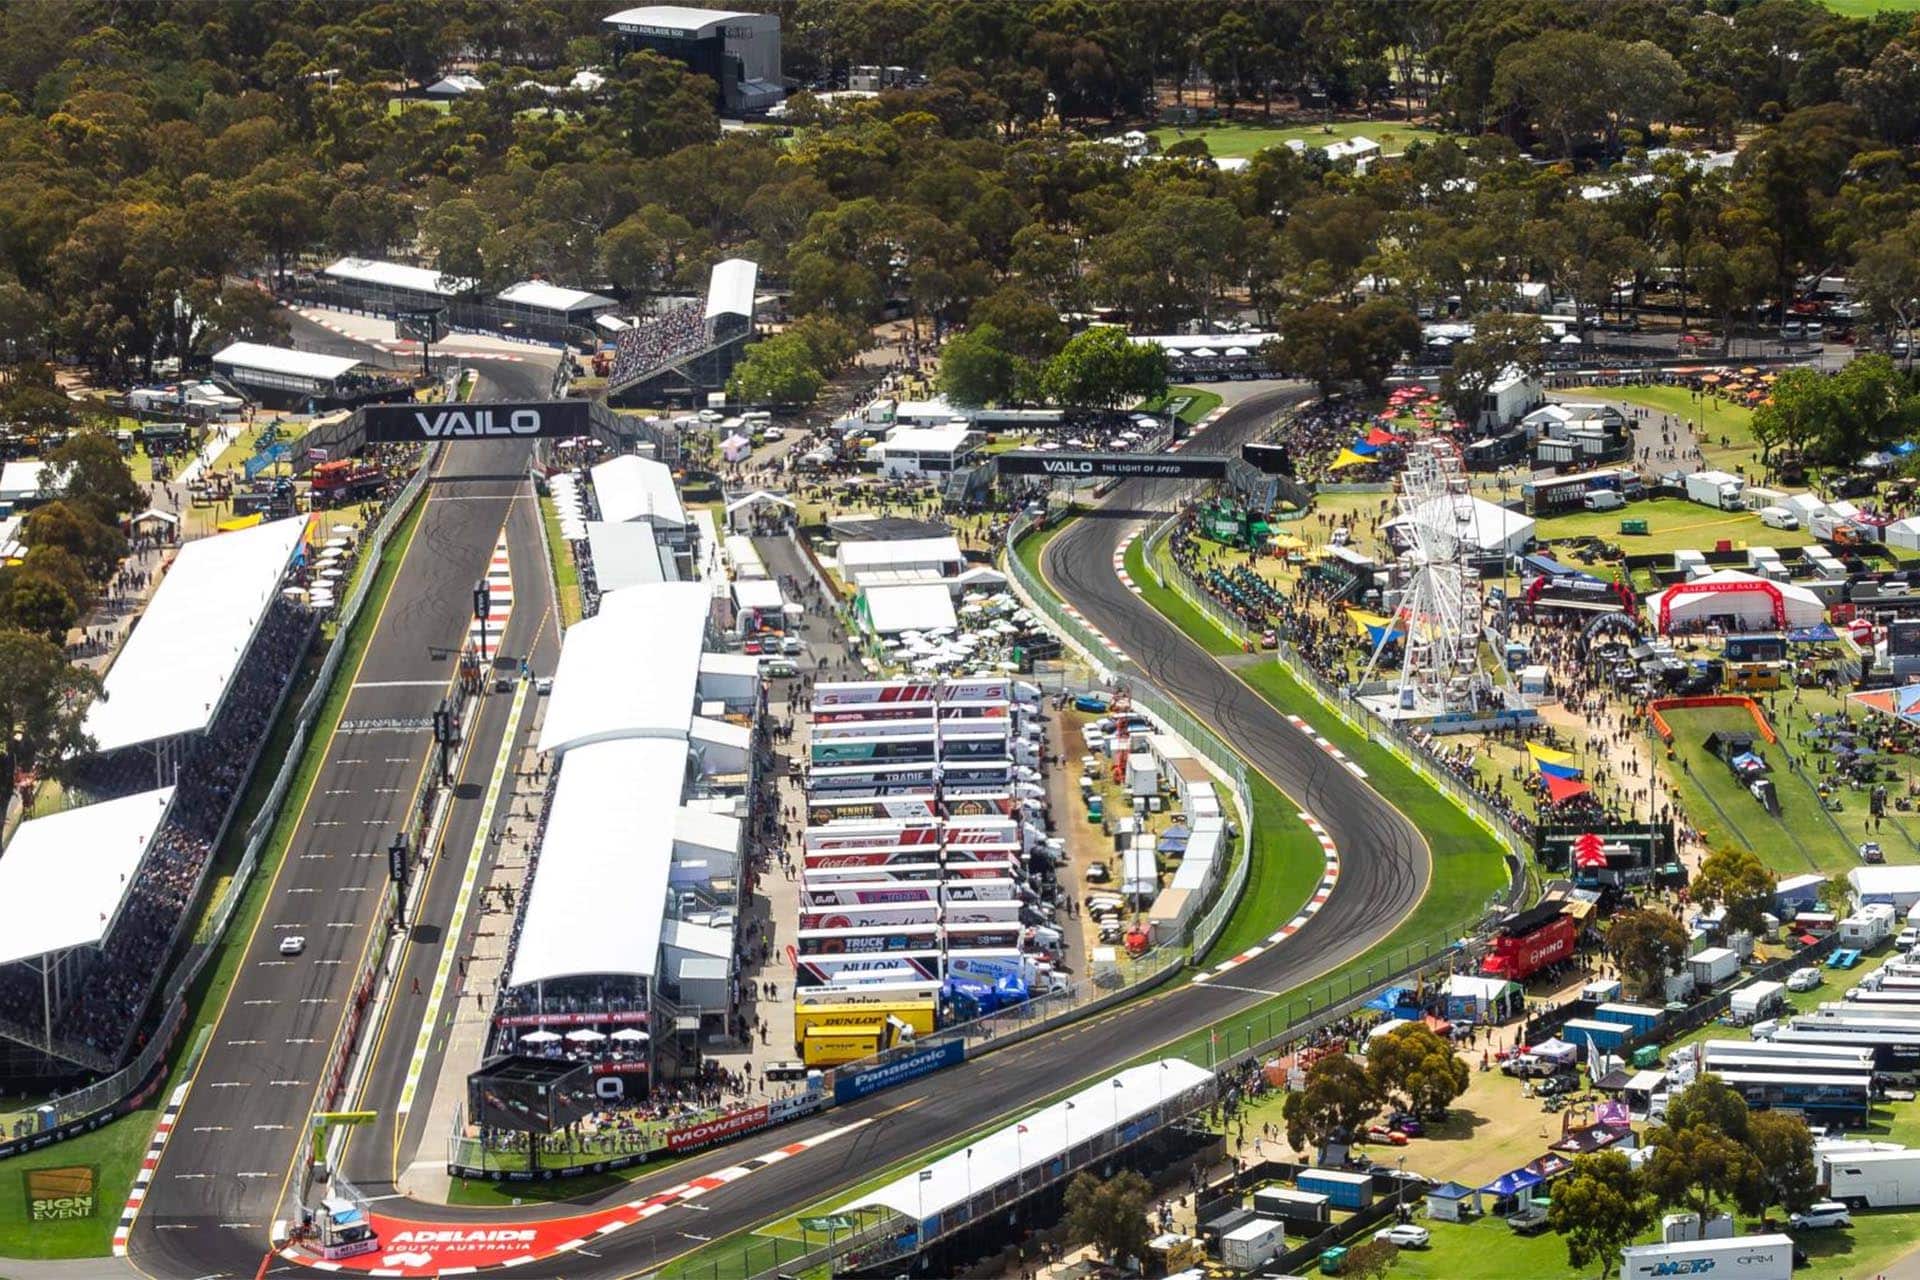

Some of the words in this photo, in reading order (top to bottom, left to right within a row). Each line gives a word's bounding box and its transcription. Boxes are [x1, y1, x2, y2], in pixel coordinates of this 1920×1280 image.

[415, 408, 541, 437] VAILO
[1043, 460, 1093, 473] VAILO
[1102, 463, 1116, 472] THE
[1118, 464, 1142, 473] LIGHT
[1143, 464, 1154, 473] OF
[1156, 464, 1181, 474] SPEED
[836, 805, 874, 817] PENRITE
[845, 937, 884, 948] TRUCK
[824, 1017, 882, 1026] DUNLOP
[855, 1049, 946, 1088] Panasonic
[770, 1092, 819, 1115] PLUS
[671, 1110, 766, 1144] MOWERS
[33, 1196, 93, 1211] SIGN
[34, 1207, 92, 1221] EVENT
[391, 1229, 537, 1243] ADELAIDE
[386, 1244, 440, 1252] SOUTH
[444, 1242, 531, 1252] AUSTRALIA
